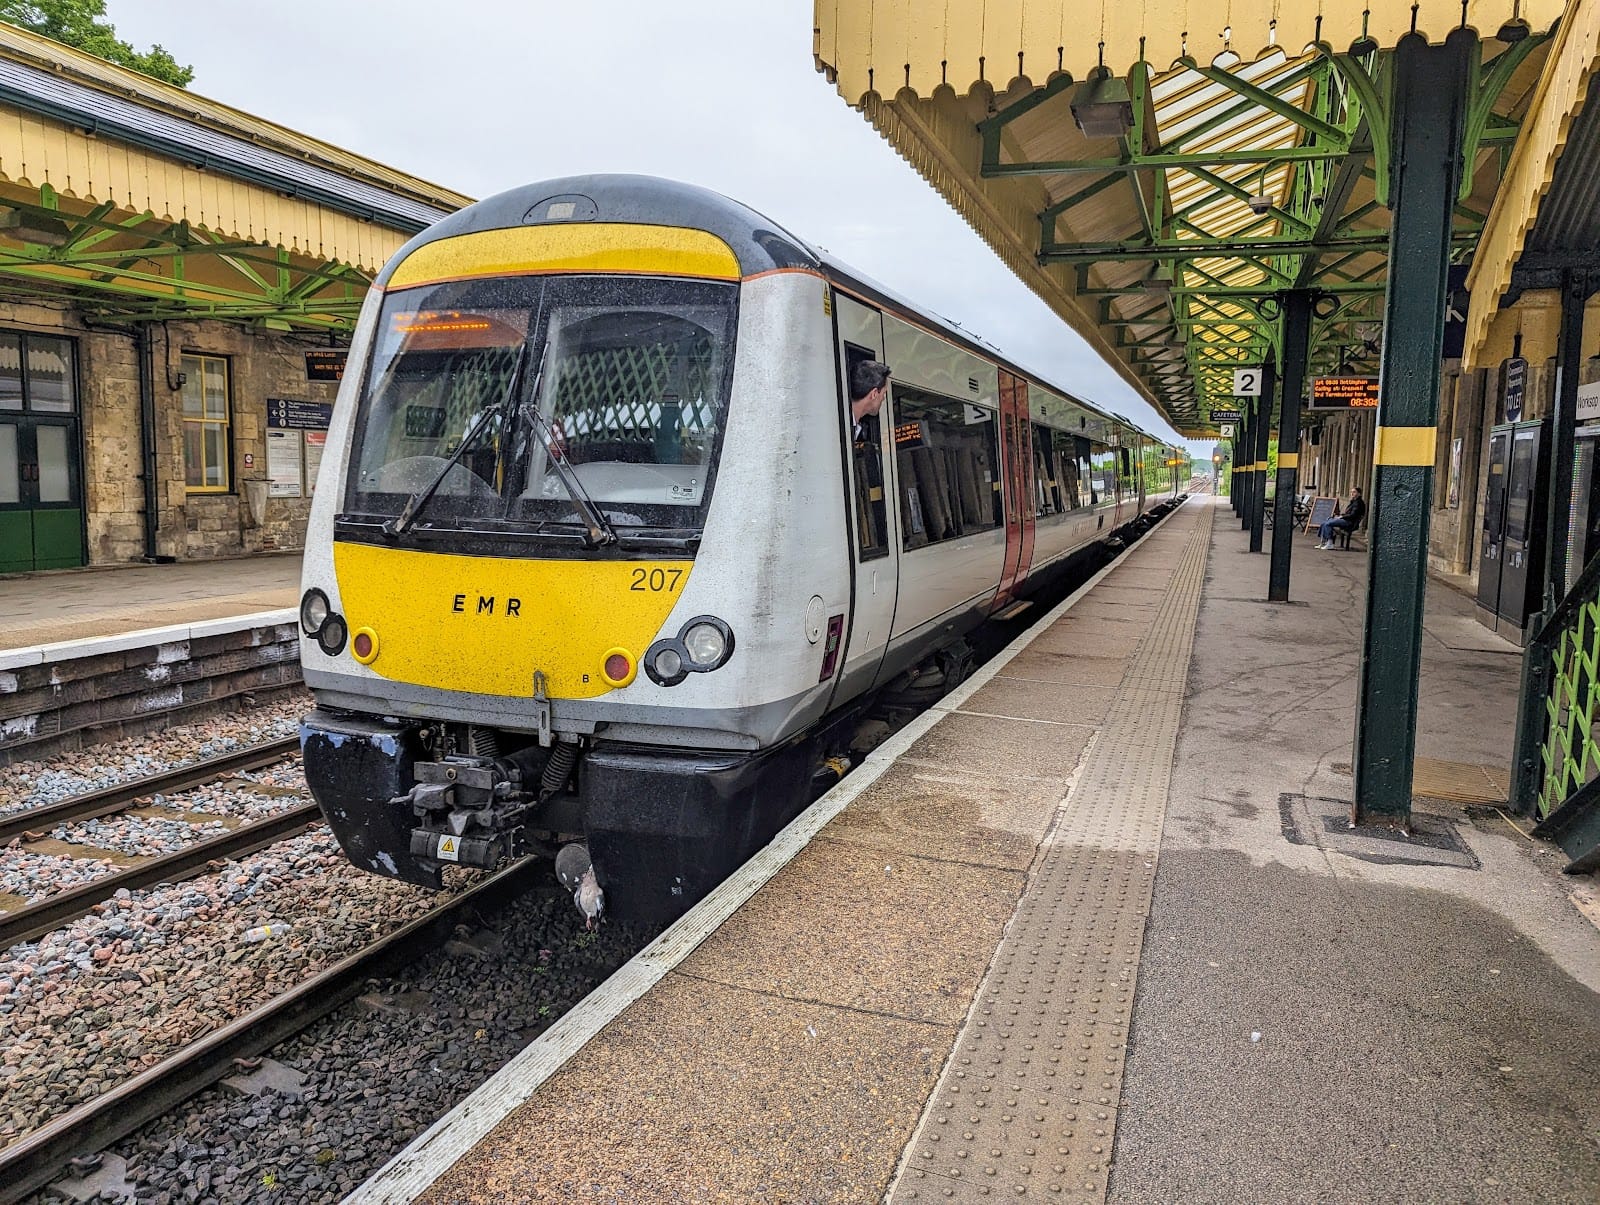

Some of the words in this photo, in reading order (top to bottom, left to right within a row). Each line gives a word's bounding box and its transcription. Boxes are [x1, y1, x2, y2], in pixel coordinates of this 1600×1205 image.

[1241, 374, 1255, 392] 2
[1223, 427, 1230, 435] 2
[630, 568, 683, 592] 207
[452, 594, 521, 616] EMR
[582, 674, 590, 683] B
